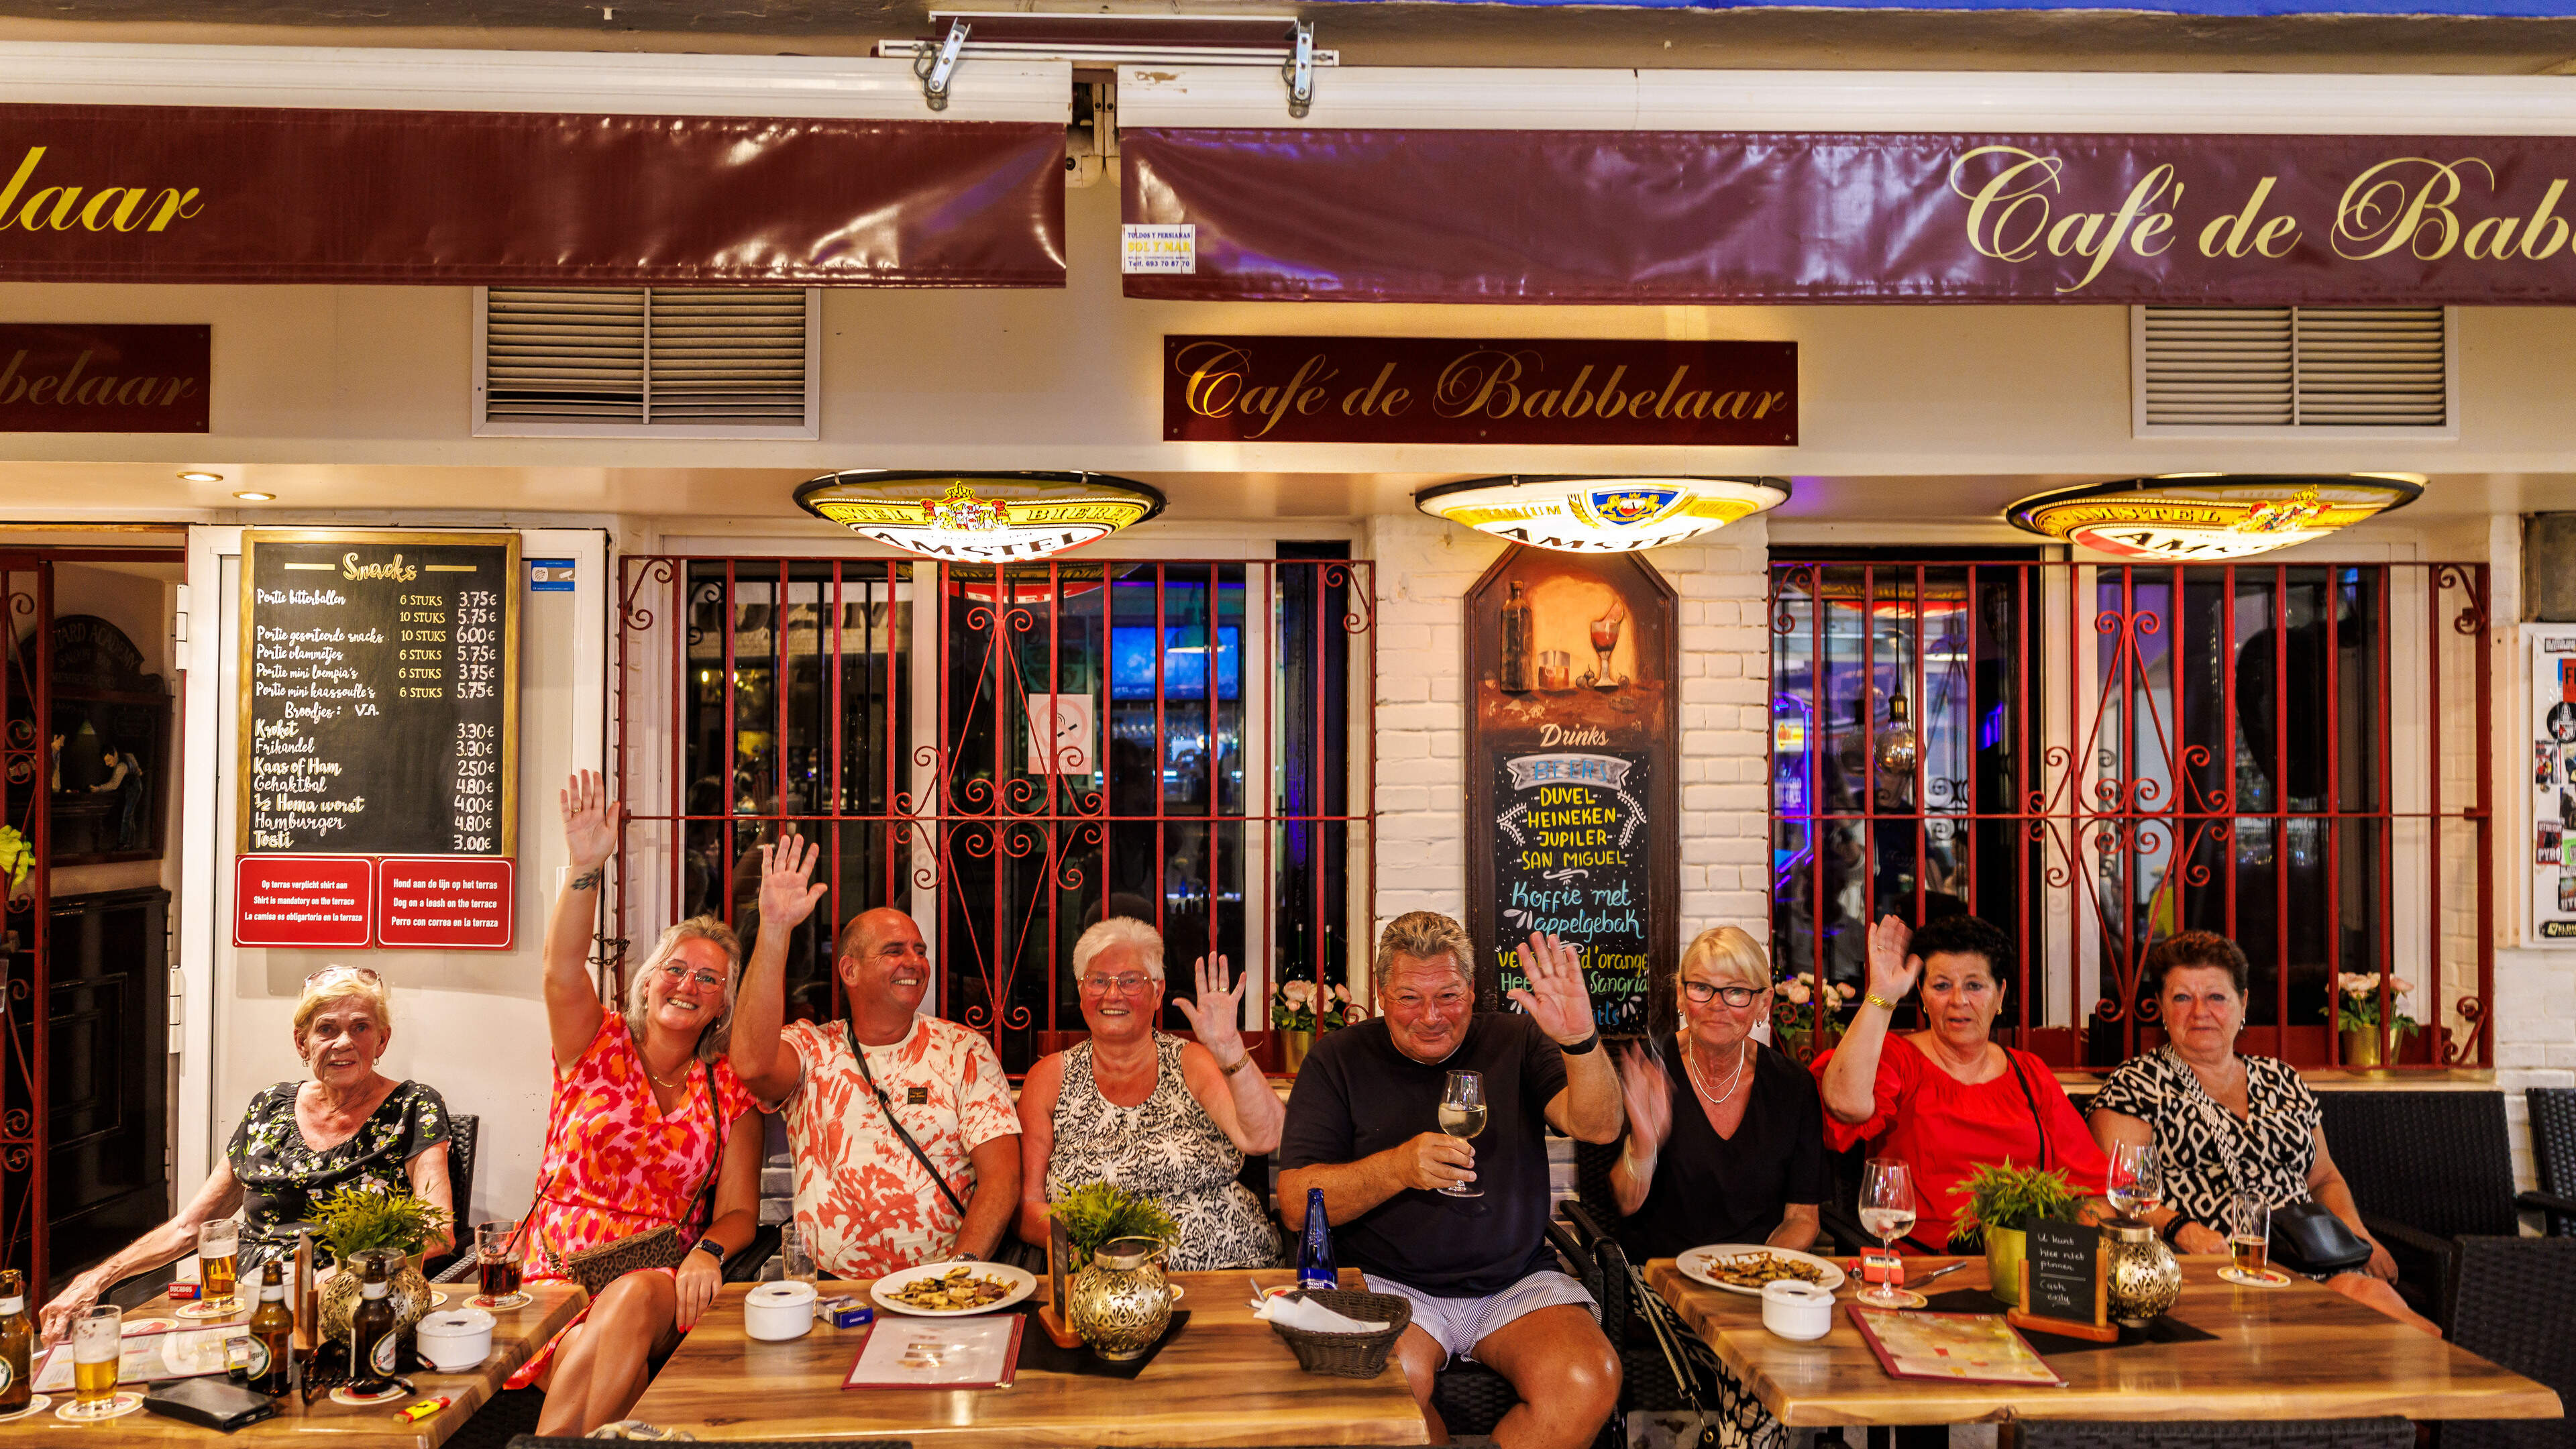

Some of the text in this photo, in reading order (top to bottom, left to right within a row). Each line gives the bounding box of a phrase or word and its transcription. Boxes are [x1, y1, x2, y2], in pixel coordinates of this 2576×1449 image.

[1949, 144, 2576, 293] Café de Bab
[1128, 241, 1191, 252] SOL Y MAR
[1175, 341, 1790, 439] Café de Babbelaar
[2068, 506, 2221, 523] AMSTEL
[343, 552, 417, 582] Snacks
[257, 588, 287, 604] Portie
[289, 589, 346, 605] bitterballen
[400, 594, 407, 605] 6
[410, 595, 443, 606] STUKS
[400, 612, 411, 622] 10
[414, 612, 445, 624] STUKS
[257, 625, 288, 641] Portie
[289, 627, 345, 647] gesorteerde
[348, 627, 384, 643] snacks
[401, 630, 413, 641] 10
[416, 630, 446, 642] STUKS
[256, 643, 287, 660] Portie
[289, 645, 343, 665] vlammetjes
[399, 649, 407, 660] 6
[409, 649, 442, 660] STUKS
[256, 662, 288, 678] Portie
[290, 667, 310, 678] mini
[312, 664, 359, 684] loempia's
[398, 667, 407, 679] 6
[409, 668, 441, 680] STUKS
[256, 681, 286, 698] Portie
[288, 685, 309, 698] mini
[399, 687, 407, 698] 6
[410, 688, 442, 698] STUKS
[255, 718, 299, 739] Kroket
[1540, 723, 1609, 747] Drinks
[256, 737, 315, 755] Frikandel
[253, 756, 289, 775] Kaas
[290, 757, 306, 777] of
[308, 757, 342, 776] Ham
[1535, 760, 1607, 782] BEERS
[254, 775, 327, 794] Gehaktbal
[276, 793, 318, 814] Hema
[320, 796, 365, 813] worst
[1540, 787, 1596, 807] DUVEL
[255, 811, 346, 837] Hamburger
[1527, 807, 1617, 828] HEINEKEN
[253, 830, 294, 849] Tosti
[1539, 829, 1608, 848] JUPILER
[1522, 850, 1628, 870] SAN MIGUEL
[2538, 847, 2561, 862] PYRO
[262, 879, 347, 891] Op terras verplicht shirt aan
[393, 878, 498, 891] Hond aan de lijn op het terras
[254, 896, 269, 904] Shirt
[270, 896, 276, 904] is
[277, 897, 311, 906] mandatory
[321, 897, 331, 905] the
[331, 898, 355, 906] terrace
[393, 897, 497, 909] Dog on a leash on the terrace
[1512, 879, 1631, 913] Koffie met
[244, 912, 253, 920] La
[254, 912, 276, 921] camisa
[332, 913, 339, 922] la
[339, 914, 363, 922] terraza
[391, 916, 498, 928] Perro con correa en la terraza
[1534, 908, 1645, 943] appelgebak
